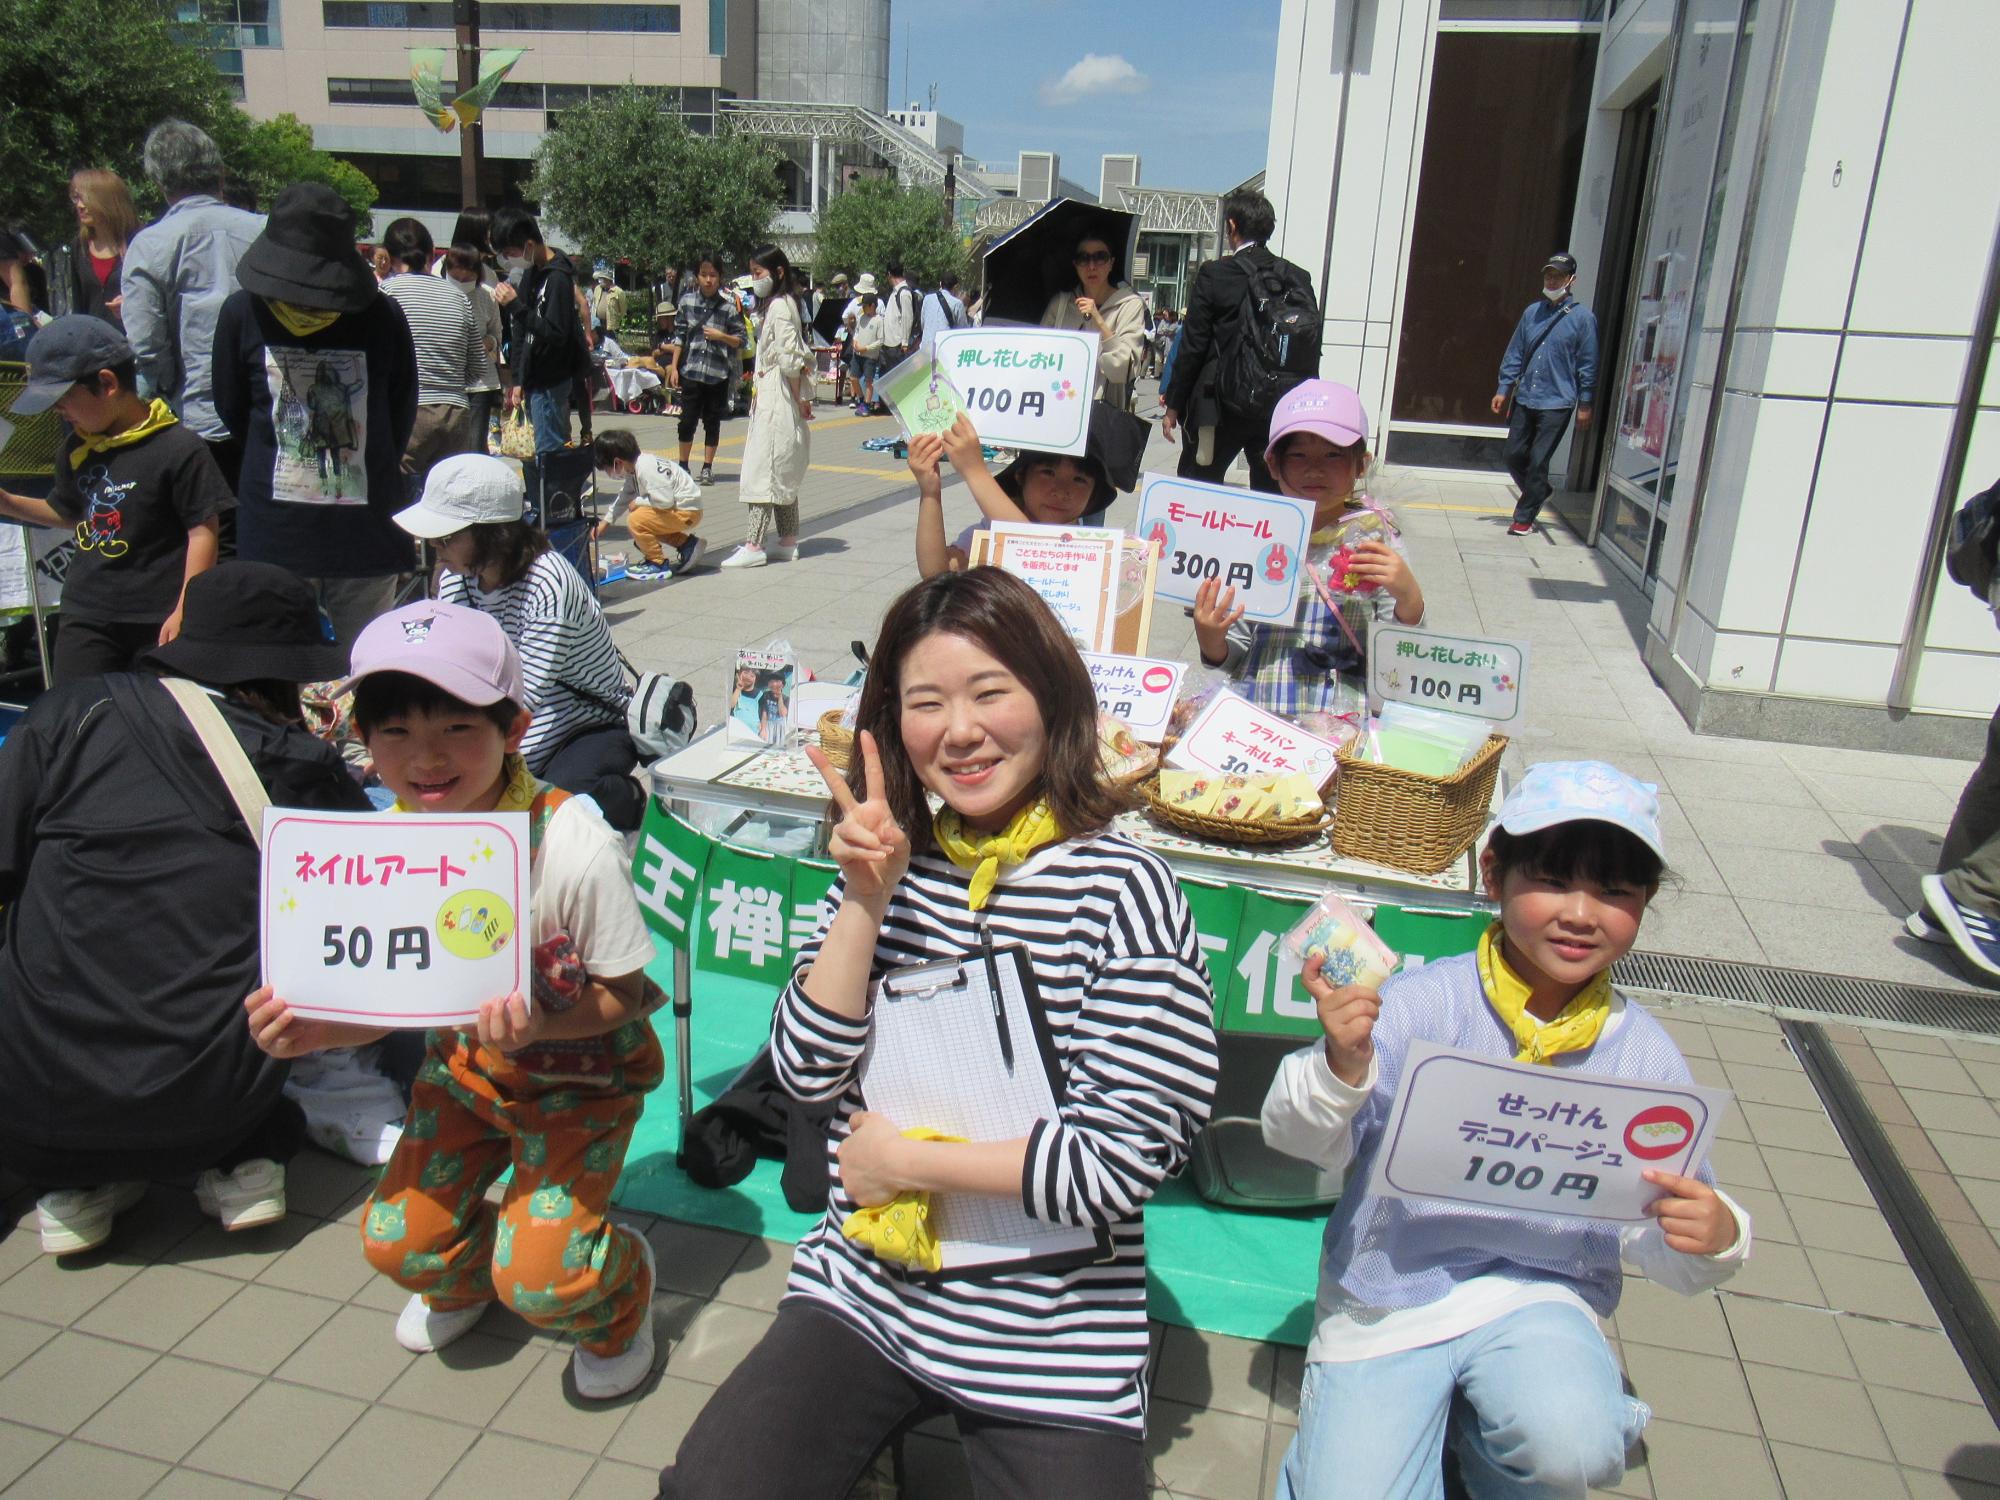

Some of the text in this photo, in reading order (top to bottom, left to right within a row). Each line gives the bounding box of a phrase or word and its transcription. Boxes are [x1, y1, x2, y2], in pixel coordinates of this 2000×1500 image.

[957, 349, 1064, 372] 押し花しおり
[966, 387, 1045, 418] 100 円
[1168, 502, 1273, 540] モールドール
[1015, 548, 1097, 562] こどもたちの手作り品
[1171, 551, 1254, 590] 300 円
[1039, 590, 1070, 599] 花しおり
[1090, 663, 1136, 679] せっけん
[1396, 640, 1497, 669] 押し花しおり
[1410, 675, 1481, 705] 100 円
[1220, 755, 1265, 774] 30
[1221, 730, 1297, 772] キーホルダー
[296, 851, 467, 887] ネイルアート
[323, 924, 431, 970] 50 円
[1498, 1092, 1608, 1130] せっけん
[1459, 1120, 1623, 1168] デコパージュ
[1464, 1155, 1600, 1200] 100 円
